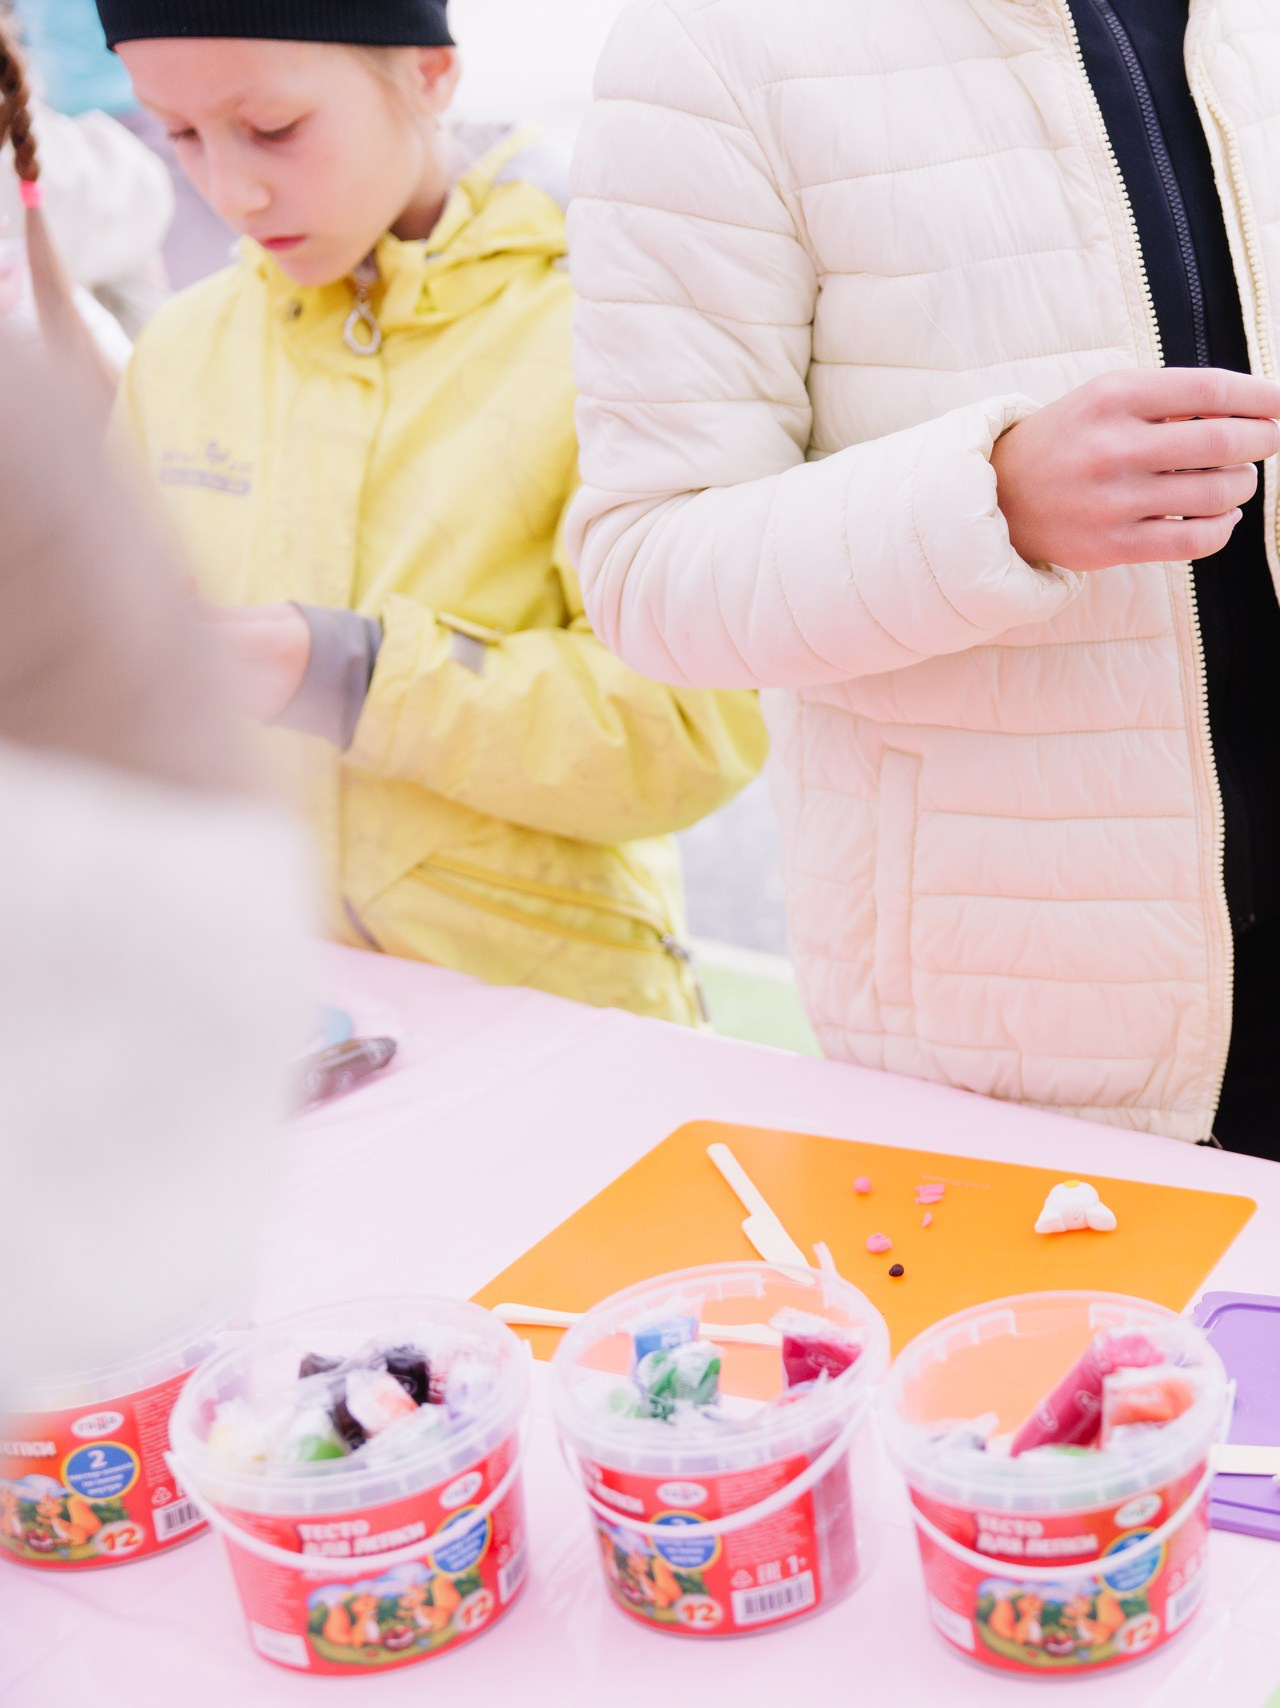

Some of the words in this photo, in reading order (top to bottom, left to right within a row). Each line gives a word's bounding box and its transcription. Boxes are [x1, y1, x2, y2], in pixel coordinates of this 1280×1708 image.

[87, 1449, 108, 1470] 2
[102, 1527, 139, 1550] 12
[297, 1519, 370, 1540] ТЕСТО
[461, 1595, 492, 1622] 12
[682, 1603, 717, 1622] 12
[1123, 1621, 1152, 1648] 12
